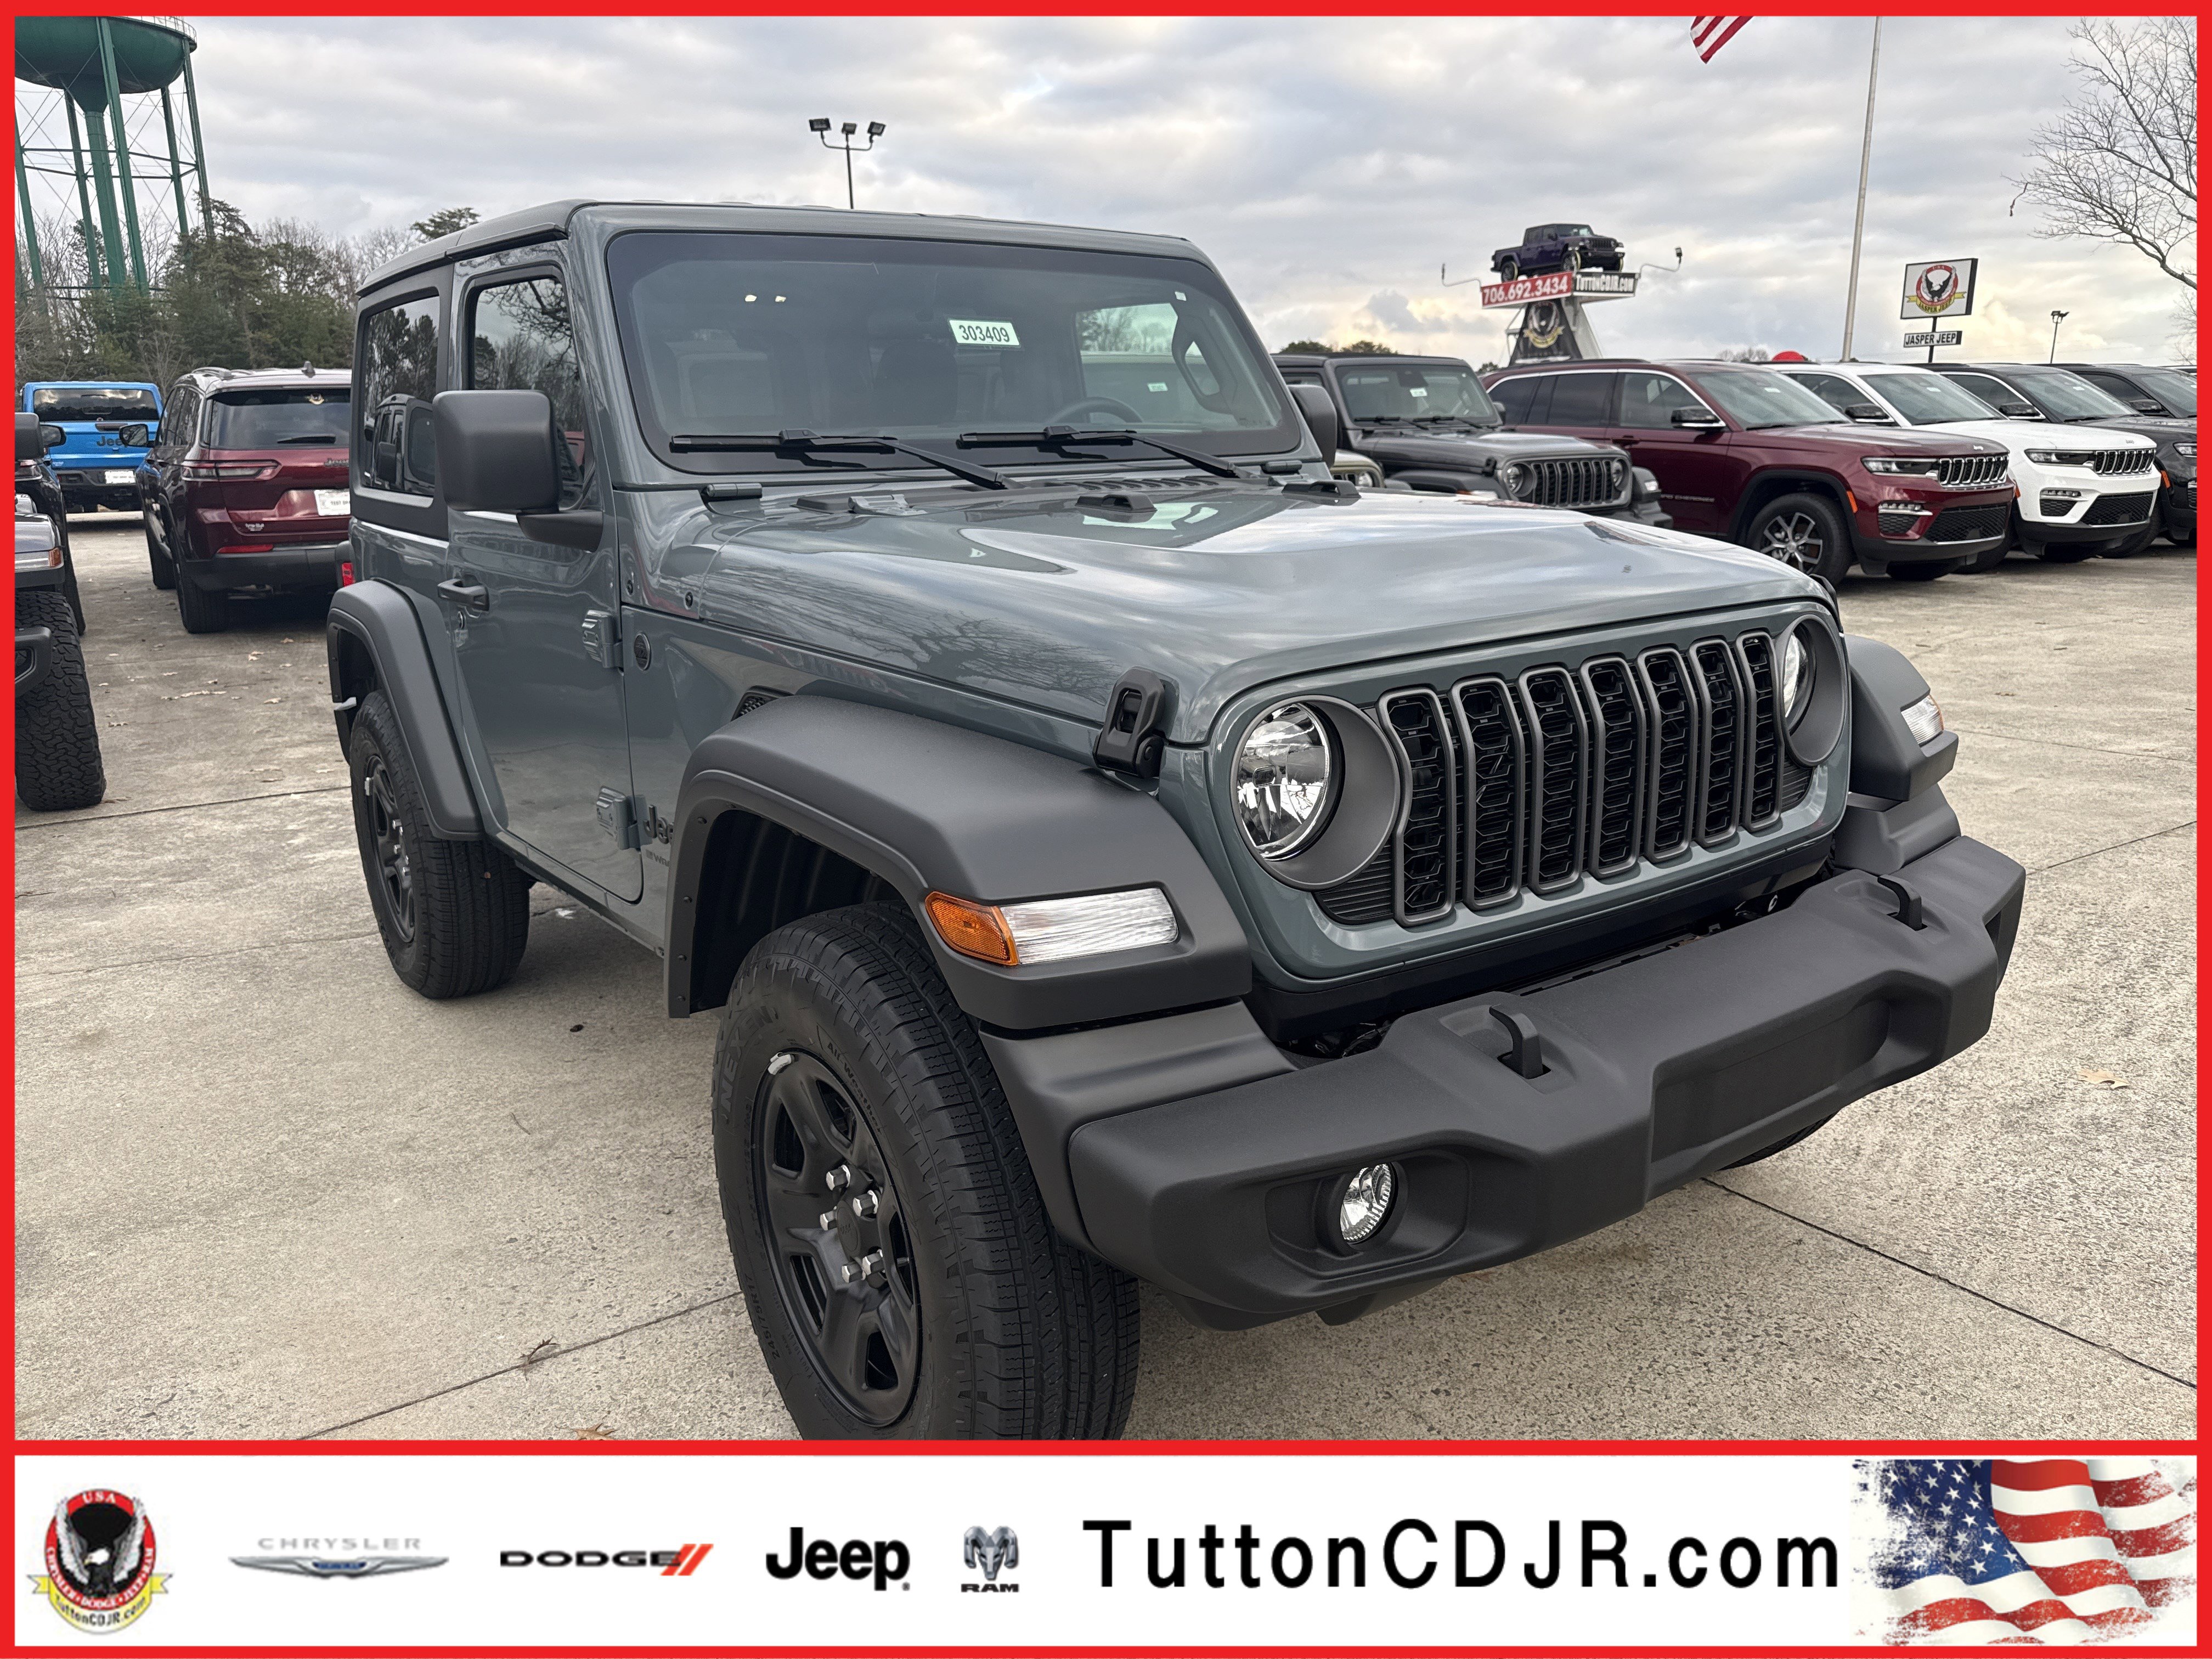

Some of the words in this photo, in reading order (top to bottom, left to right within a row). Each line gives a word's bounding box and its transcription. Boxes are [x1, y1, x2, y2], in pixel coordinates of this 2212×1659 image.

[1483, 275, 1568, 303] 706.692.3434
[959, 325, 1010, 343] 303409
[1905, 334, 1934, 345] JASPER
[1936, 332, 1956, 344] JEEP
[97, 436, 128, 447] Jee
